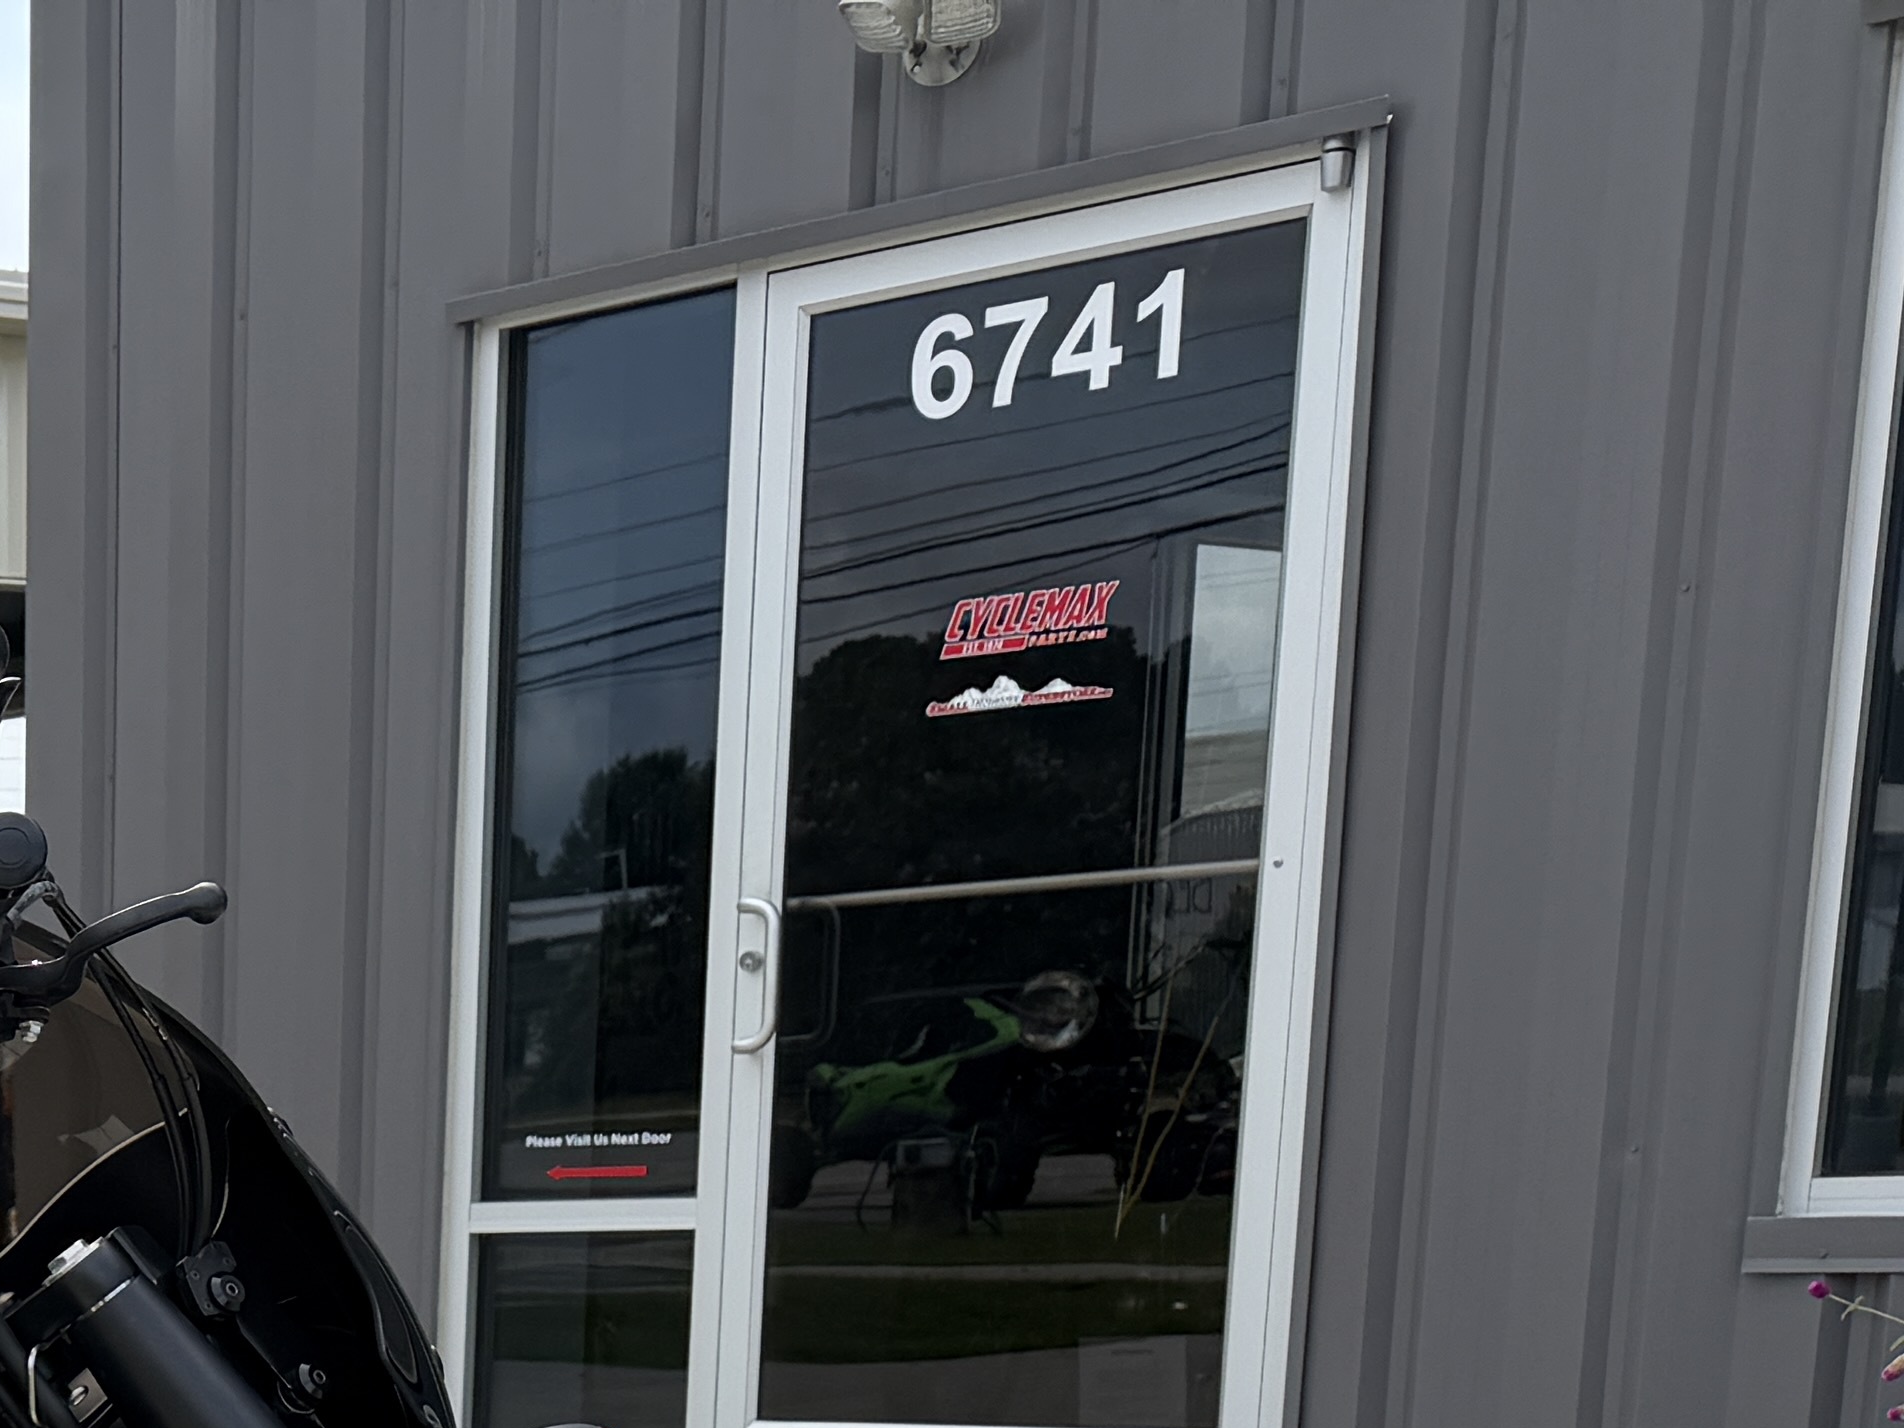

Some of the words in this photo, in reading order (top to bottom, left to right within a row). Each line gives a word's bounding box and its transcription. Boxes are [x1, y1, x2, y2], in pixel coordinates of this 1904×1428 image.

[911, 268, 1185, 420] 6741
[945, 580, 1120, 642] CYCLEMAX
[525, 1134, 563, 1148] Please
[565, 1133, 591, 1147] Visit
[593, 1133, 609, 1146] Us
[611, 1132, 639, 1145] Next
[641, 1131, 672, 1145] Door
